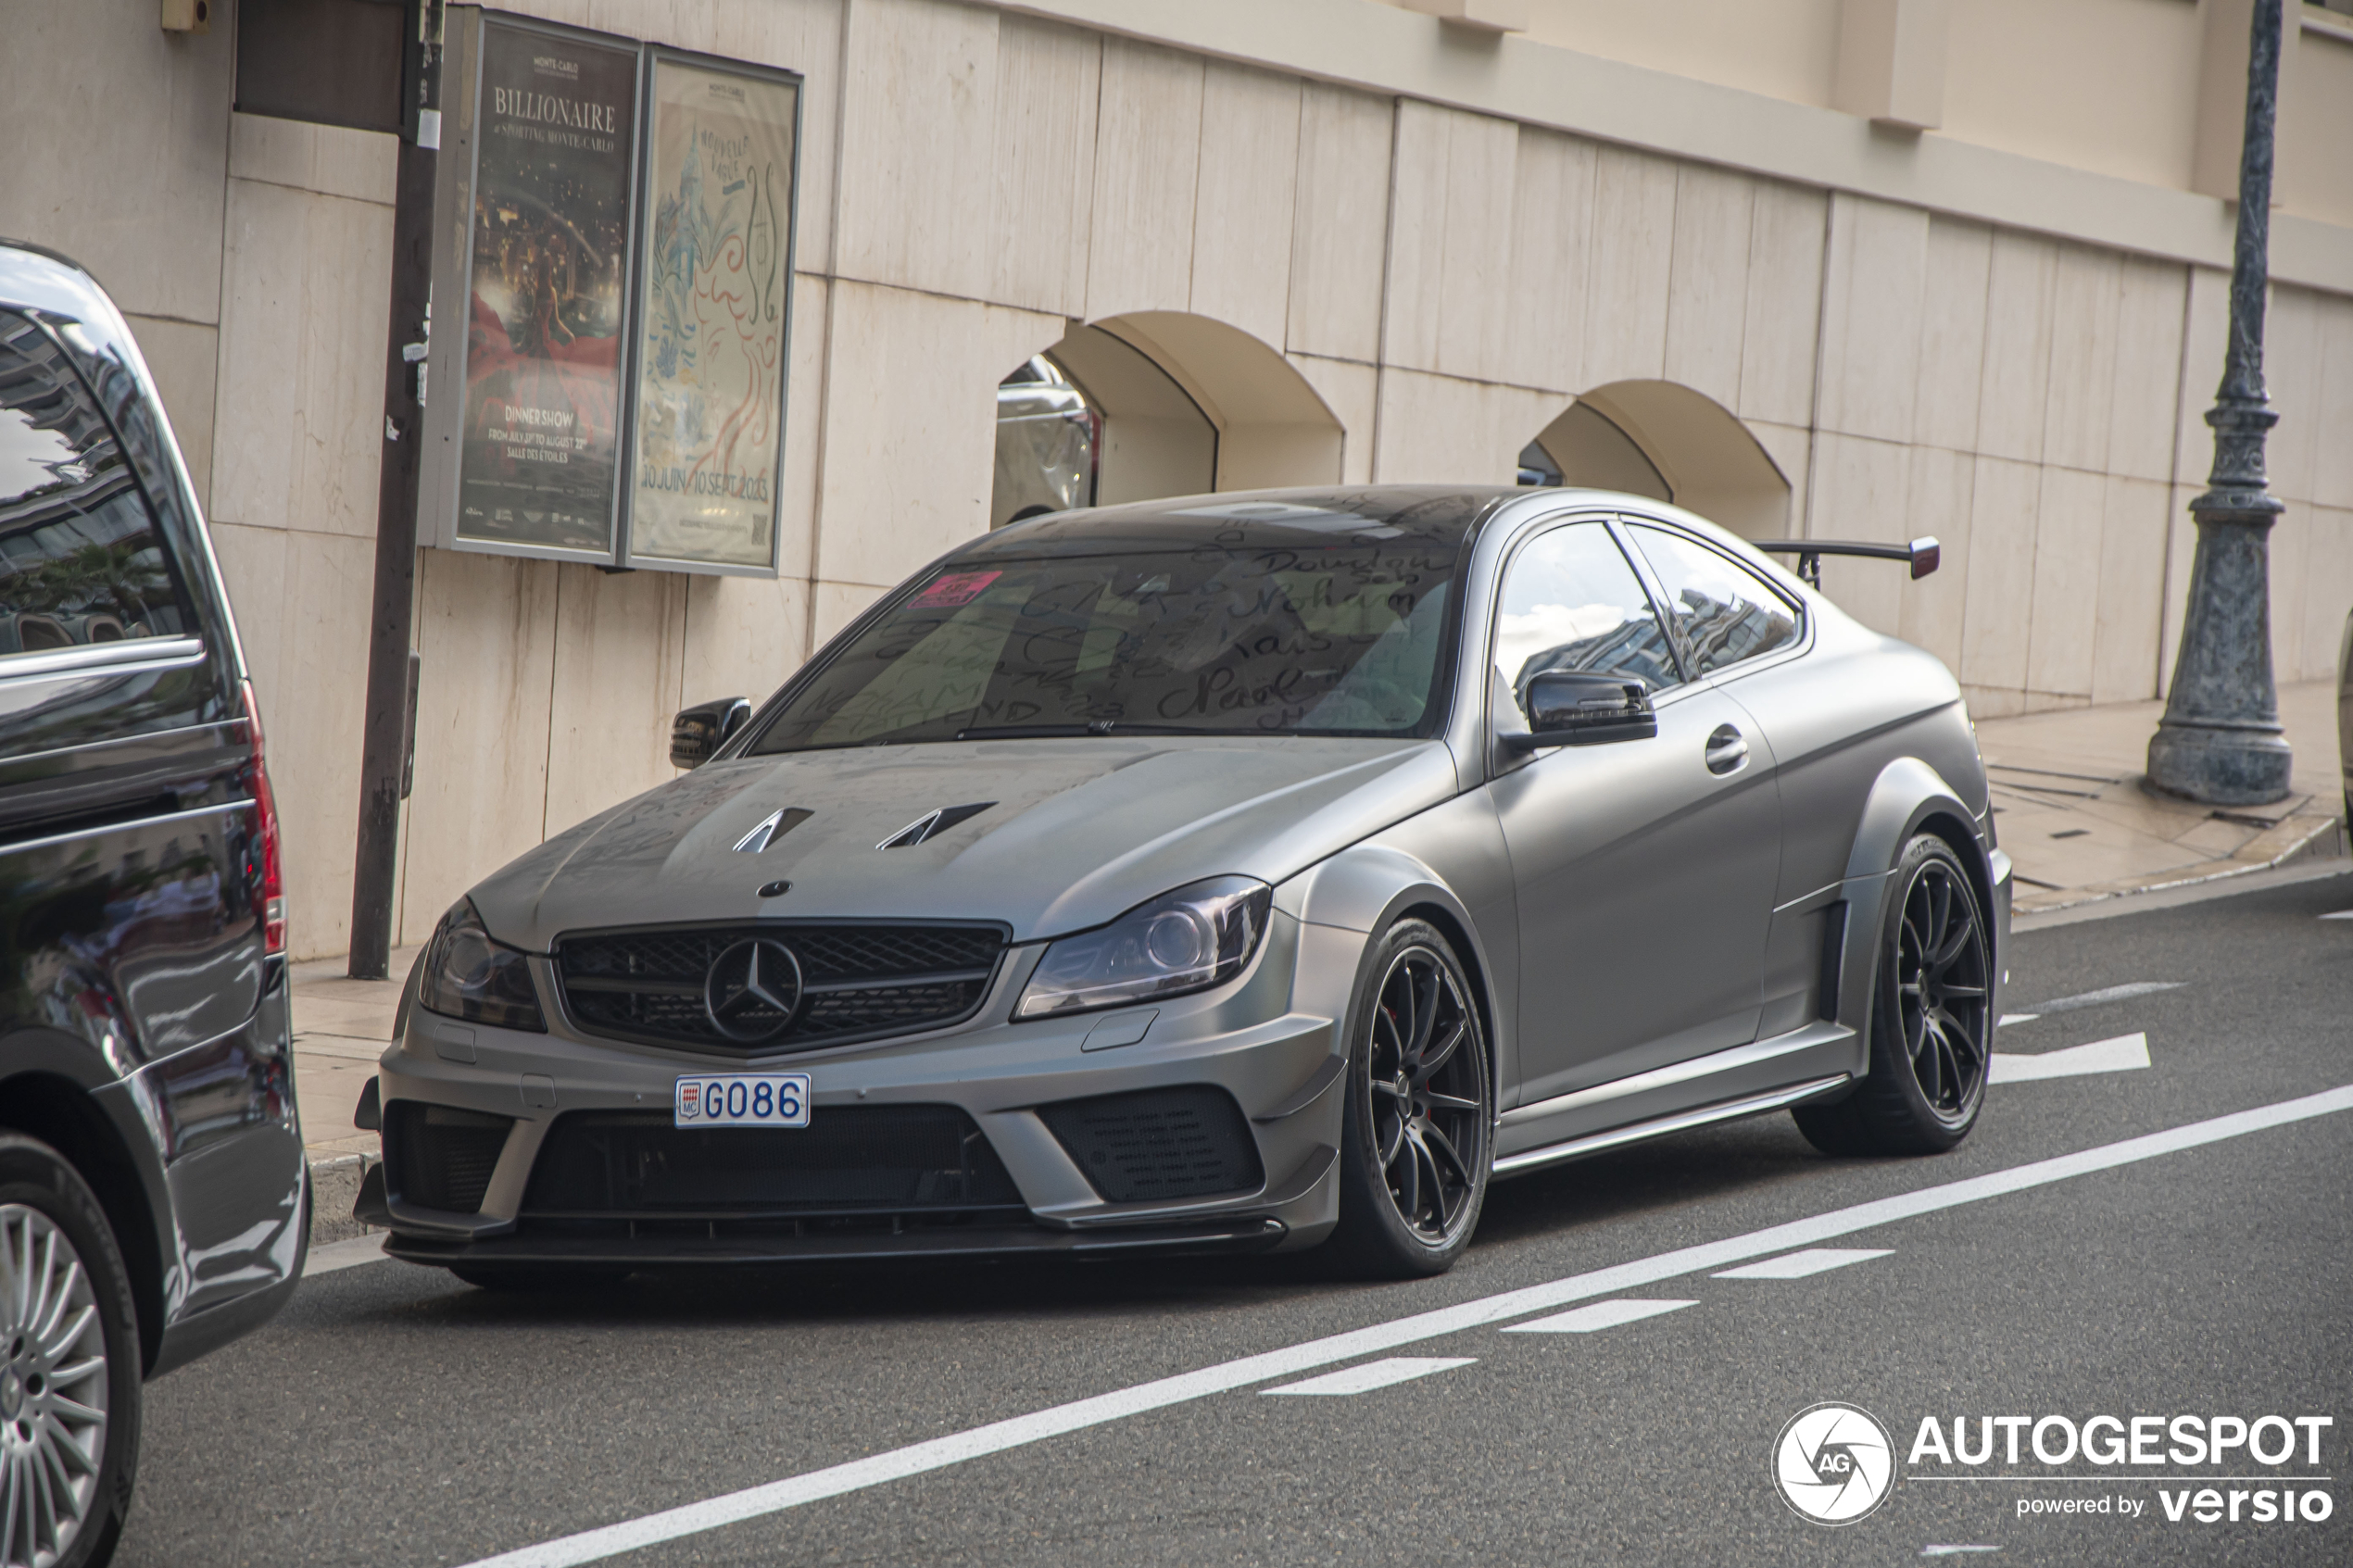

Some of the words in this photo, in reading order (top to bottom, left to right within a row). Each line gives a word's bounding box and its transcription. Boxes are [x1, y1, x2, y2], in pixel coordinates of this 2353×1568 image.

[534, 56, 579, 73] MONTE-CARLO
[495, 86, 615, 134] BILLIONAIRE
[501, 122, 545, 144] SPORTING
[547, 130, 614, 154] MONTE-CARLO
[505, 405, 541, 426] DINNER
[541, 408, 574, 429] SHOW
[488, 428, 509, 442] FROM
[509, 431, 523, 445] JULY
[535, 433, 545, 446] TO
[546, 435, 574, 449] AUGUST
[507, 445, 526, 459] SALLE
[527, 447, 538, 460] DES
[641, 464, 657, 489] 10
[657, 467, 686, 493] JUIN
[694, 470, 707, 495] 10
[738, 475, 769, 502] 2023
[684, 1102, 697, 1112] MC
